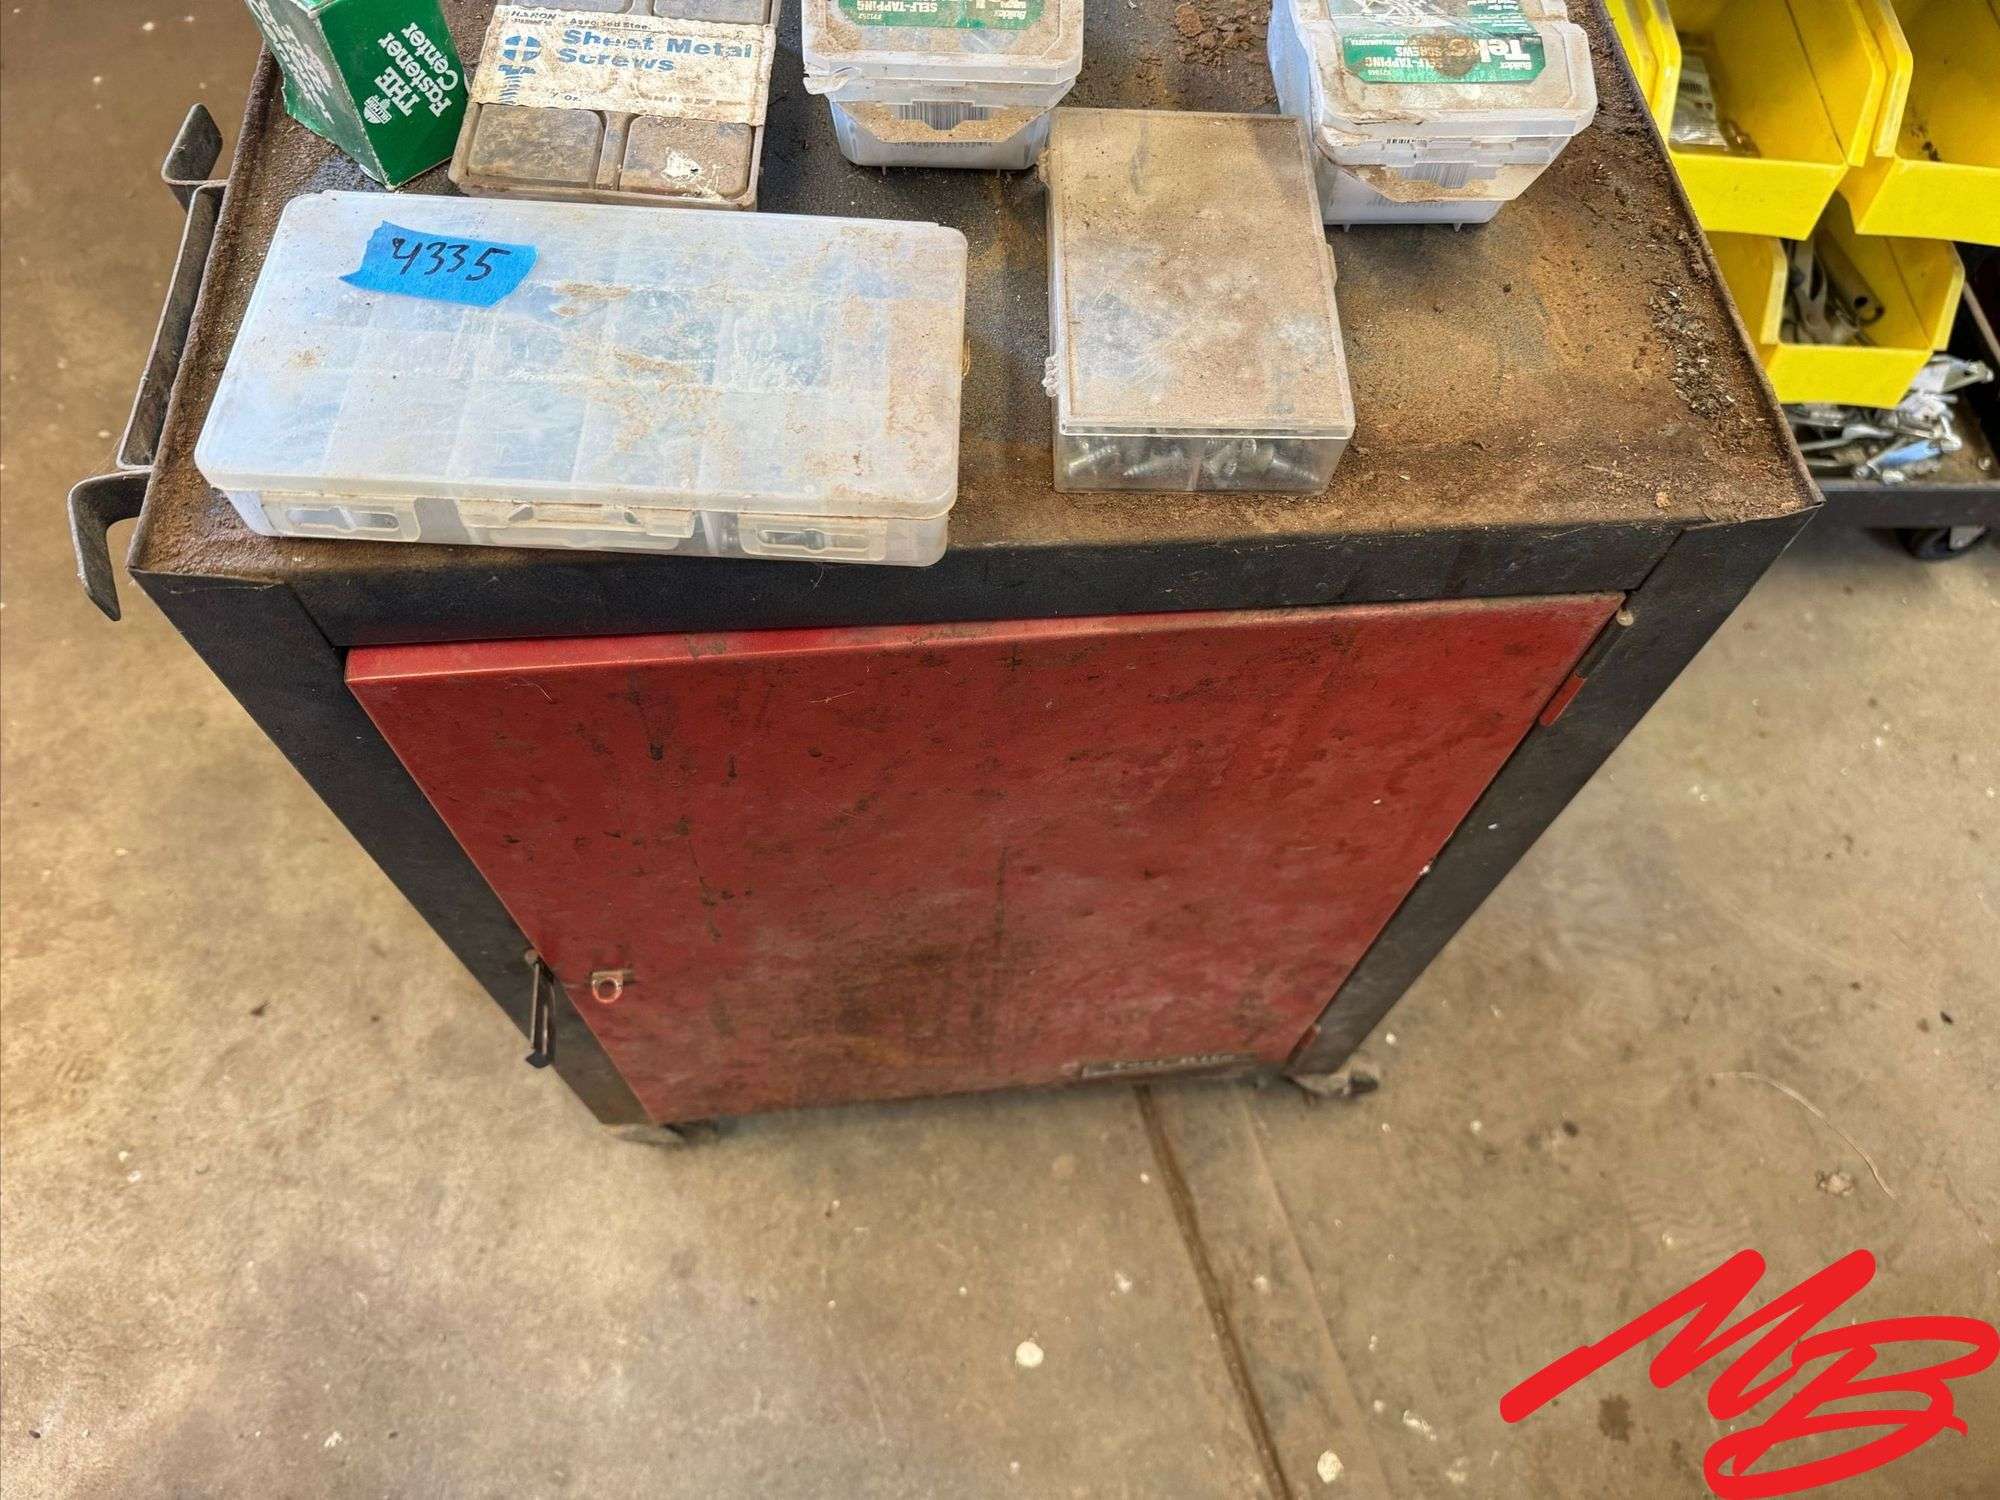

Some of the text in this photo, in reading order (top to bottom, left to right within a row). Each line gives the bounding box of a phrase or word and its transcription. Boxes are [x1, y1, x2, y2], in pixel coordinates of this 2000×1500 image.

[402, 22, 458, 91] Center
[558, 48, 674, 71] Screws
[562, 29, 753, 58] Sheet Metal
[374, 66, 421, 117] THE
[378, 32, 452, 117] Fastener
[392, 238, 511, 281] 4335
